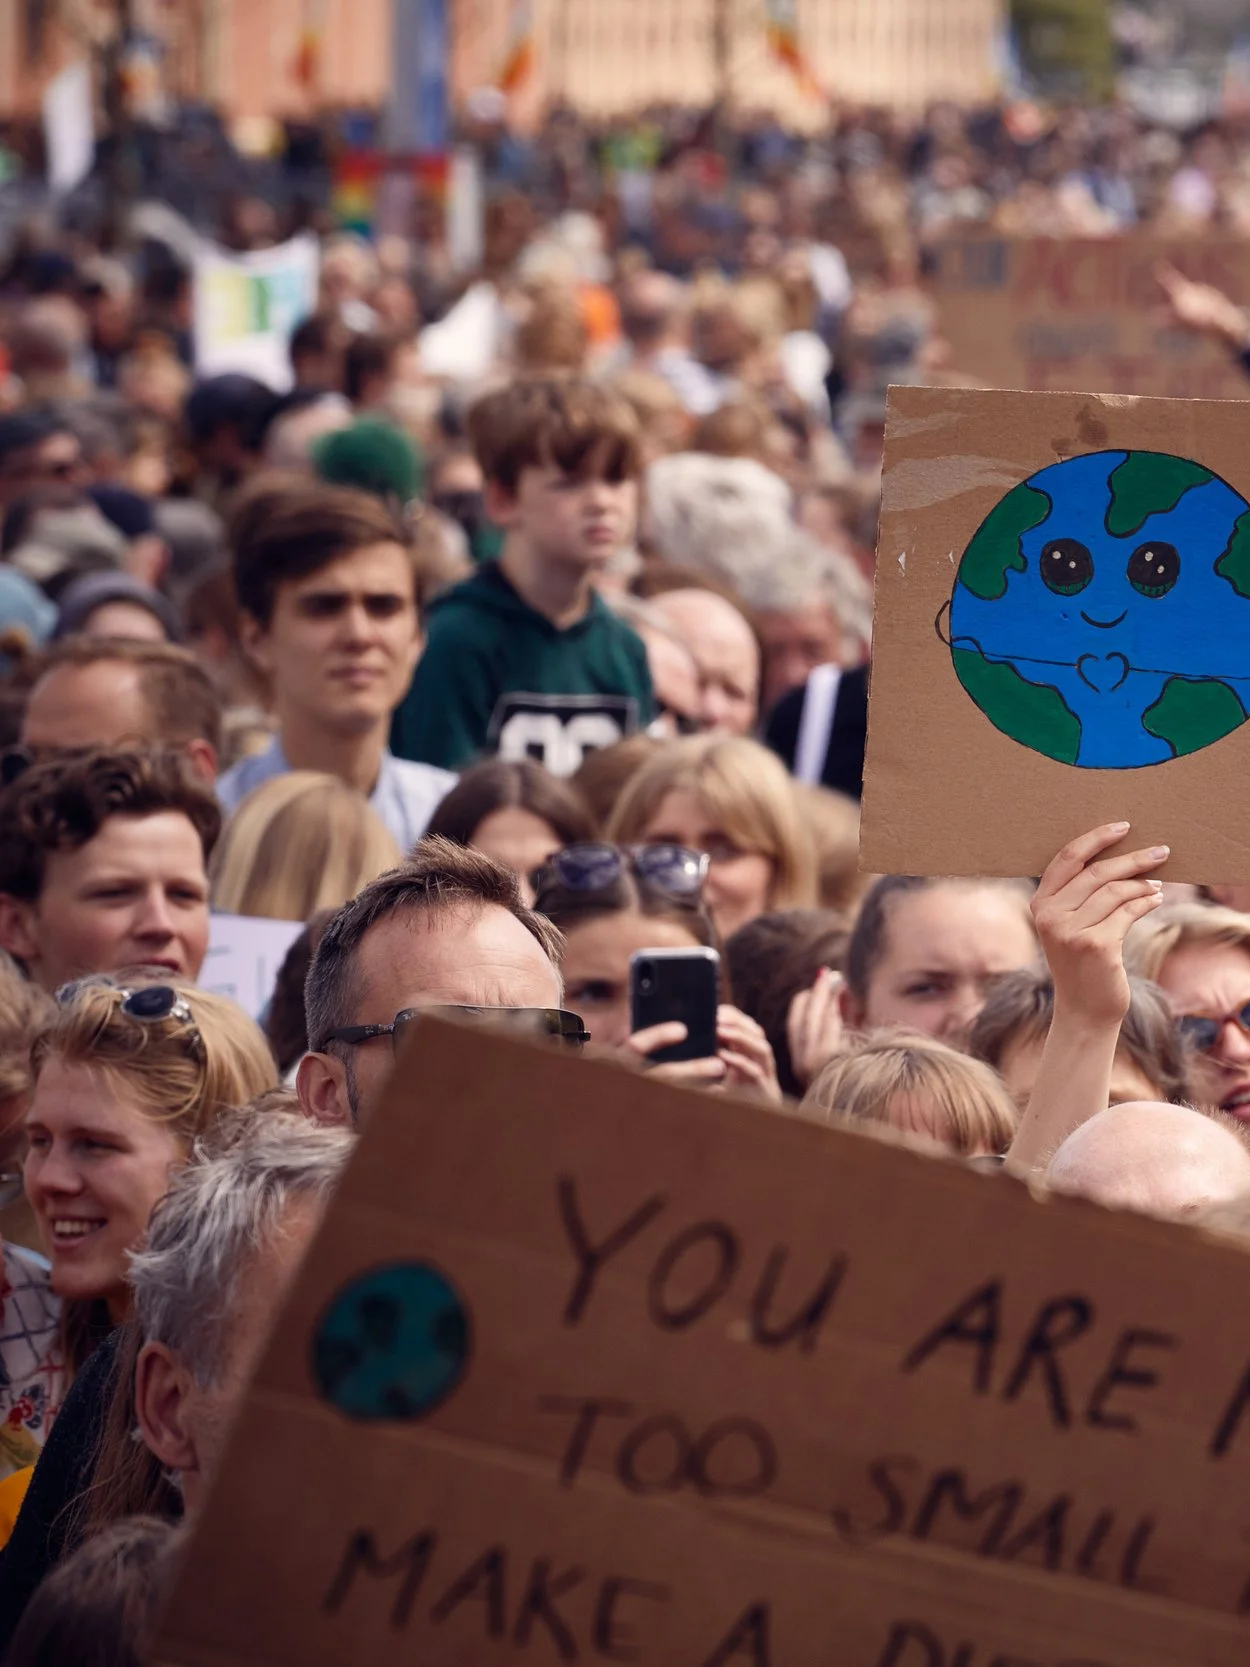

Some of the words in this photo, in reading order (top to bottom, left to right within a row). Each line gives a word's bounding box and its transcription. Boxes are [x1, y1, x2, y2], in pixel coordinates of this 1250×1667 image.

[556, 1175, 847, 1354] YOU
[903, 1276, 1181, 1432] ARE
[323, 1526, 671, 1662] MAKE
[702, 1600, 772, 1667] A
[538, 1394, 779, 1497] TOO
[830, 1454, 1176, 1597] SMALL
